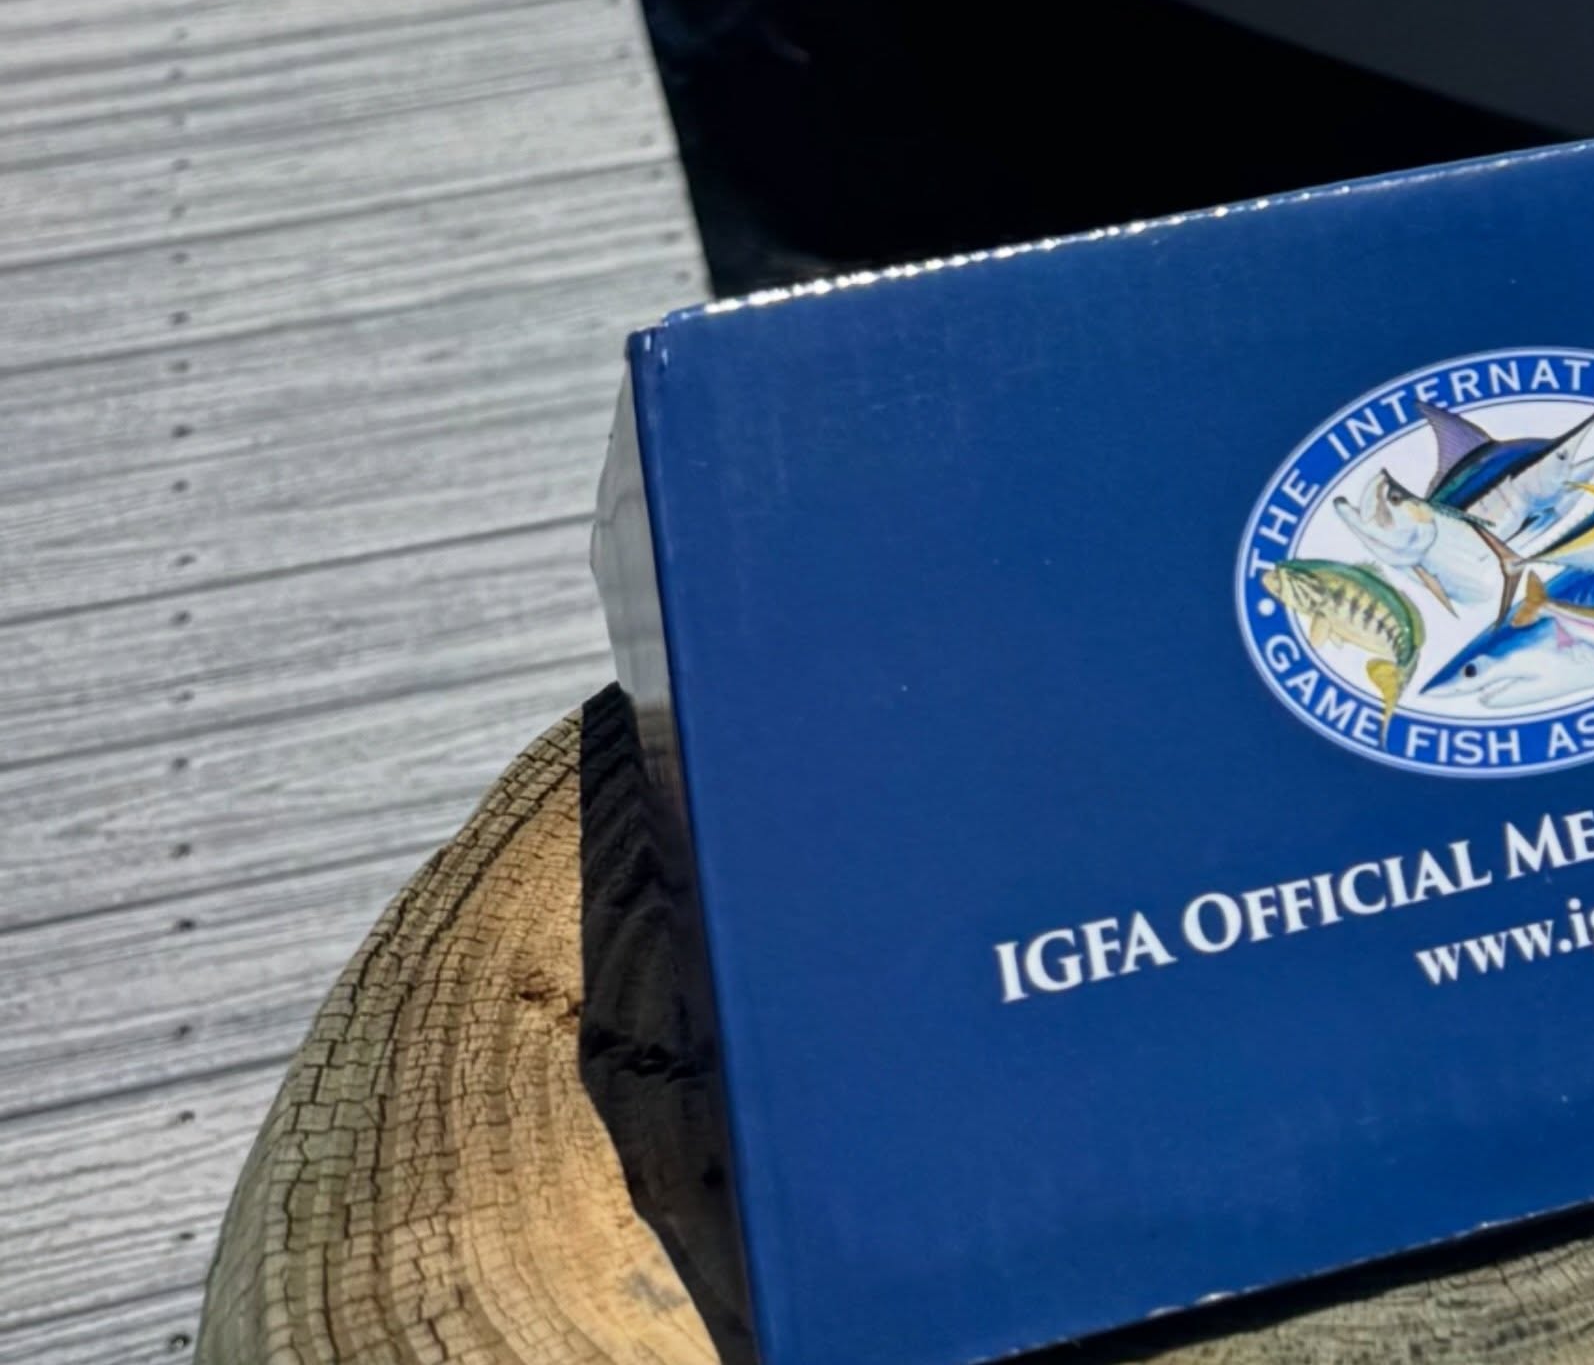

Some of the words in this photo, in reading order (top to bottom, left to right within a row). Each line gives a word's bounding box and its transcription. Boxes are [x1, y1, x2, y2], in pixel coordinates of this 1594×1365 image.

[1249, 468, 1320, 579] THE
[1264, 633, 1382, 748] GAME
[1404, 724, 1522, 766] FISH
[995, 912, 1175, 1002] IGFA
[1183, 841, 1492, 953] OFFICIAL
